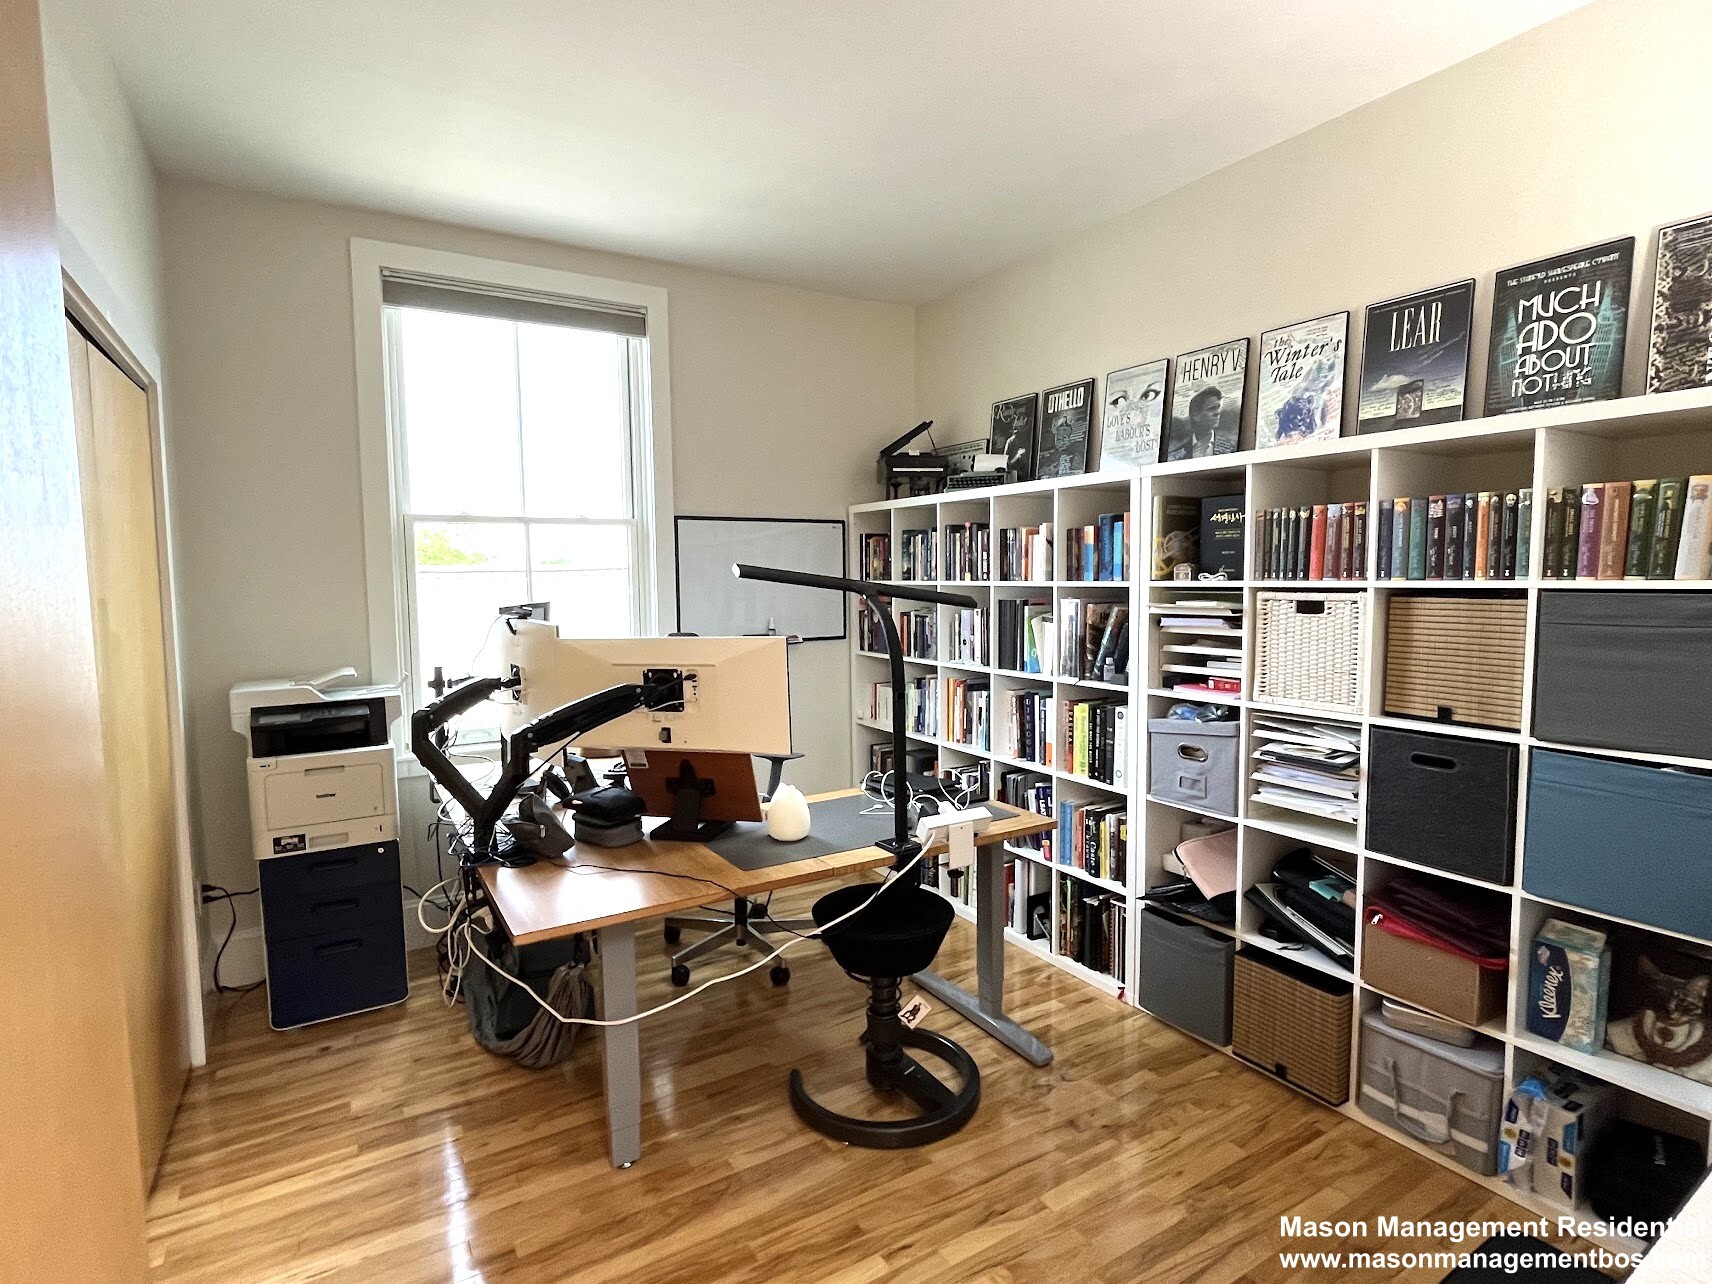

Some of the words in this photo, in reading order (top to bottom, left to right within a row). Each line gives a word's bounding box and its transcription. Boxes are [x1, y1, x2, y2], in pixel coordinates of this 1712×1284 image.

[1543, 273, 1577, 284] PRESENTS
[1517, 280, 1602, 324] MUCH
[1389, 301, 1442, 353] LEAR
[1515, 311, 1597, 355] ADO
[1264, 338, 1343, 367] Winter's
[1273, 335, 1290, 349] the
[1181, 351, 1229, 383] HENRY
[1231, 348, 1241, 372] V
[1270, 363, 1303, 384] Tale
[1514, 343, 1592, 378] ABOUT
[1047, 386, 1085, 414] OTHELLO
[1106, 412, 1131, 428] LOVE'S
[1115, 425, 1151, 441] LABOUR'S
[1135, 437, 1158, 453] LOST
[1089, 841, 1097, 866] Caste
[1537, 966, 1564, 1019] Kleenex
